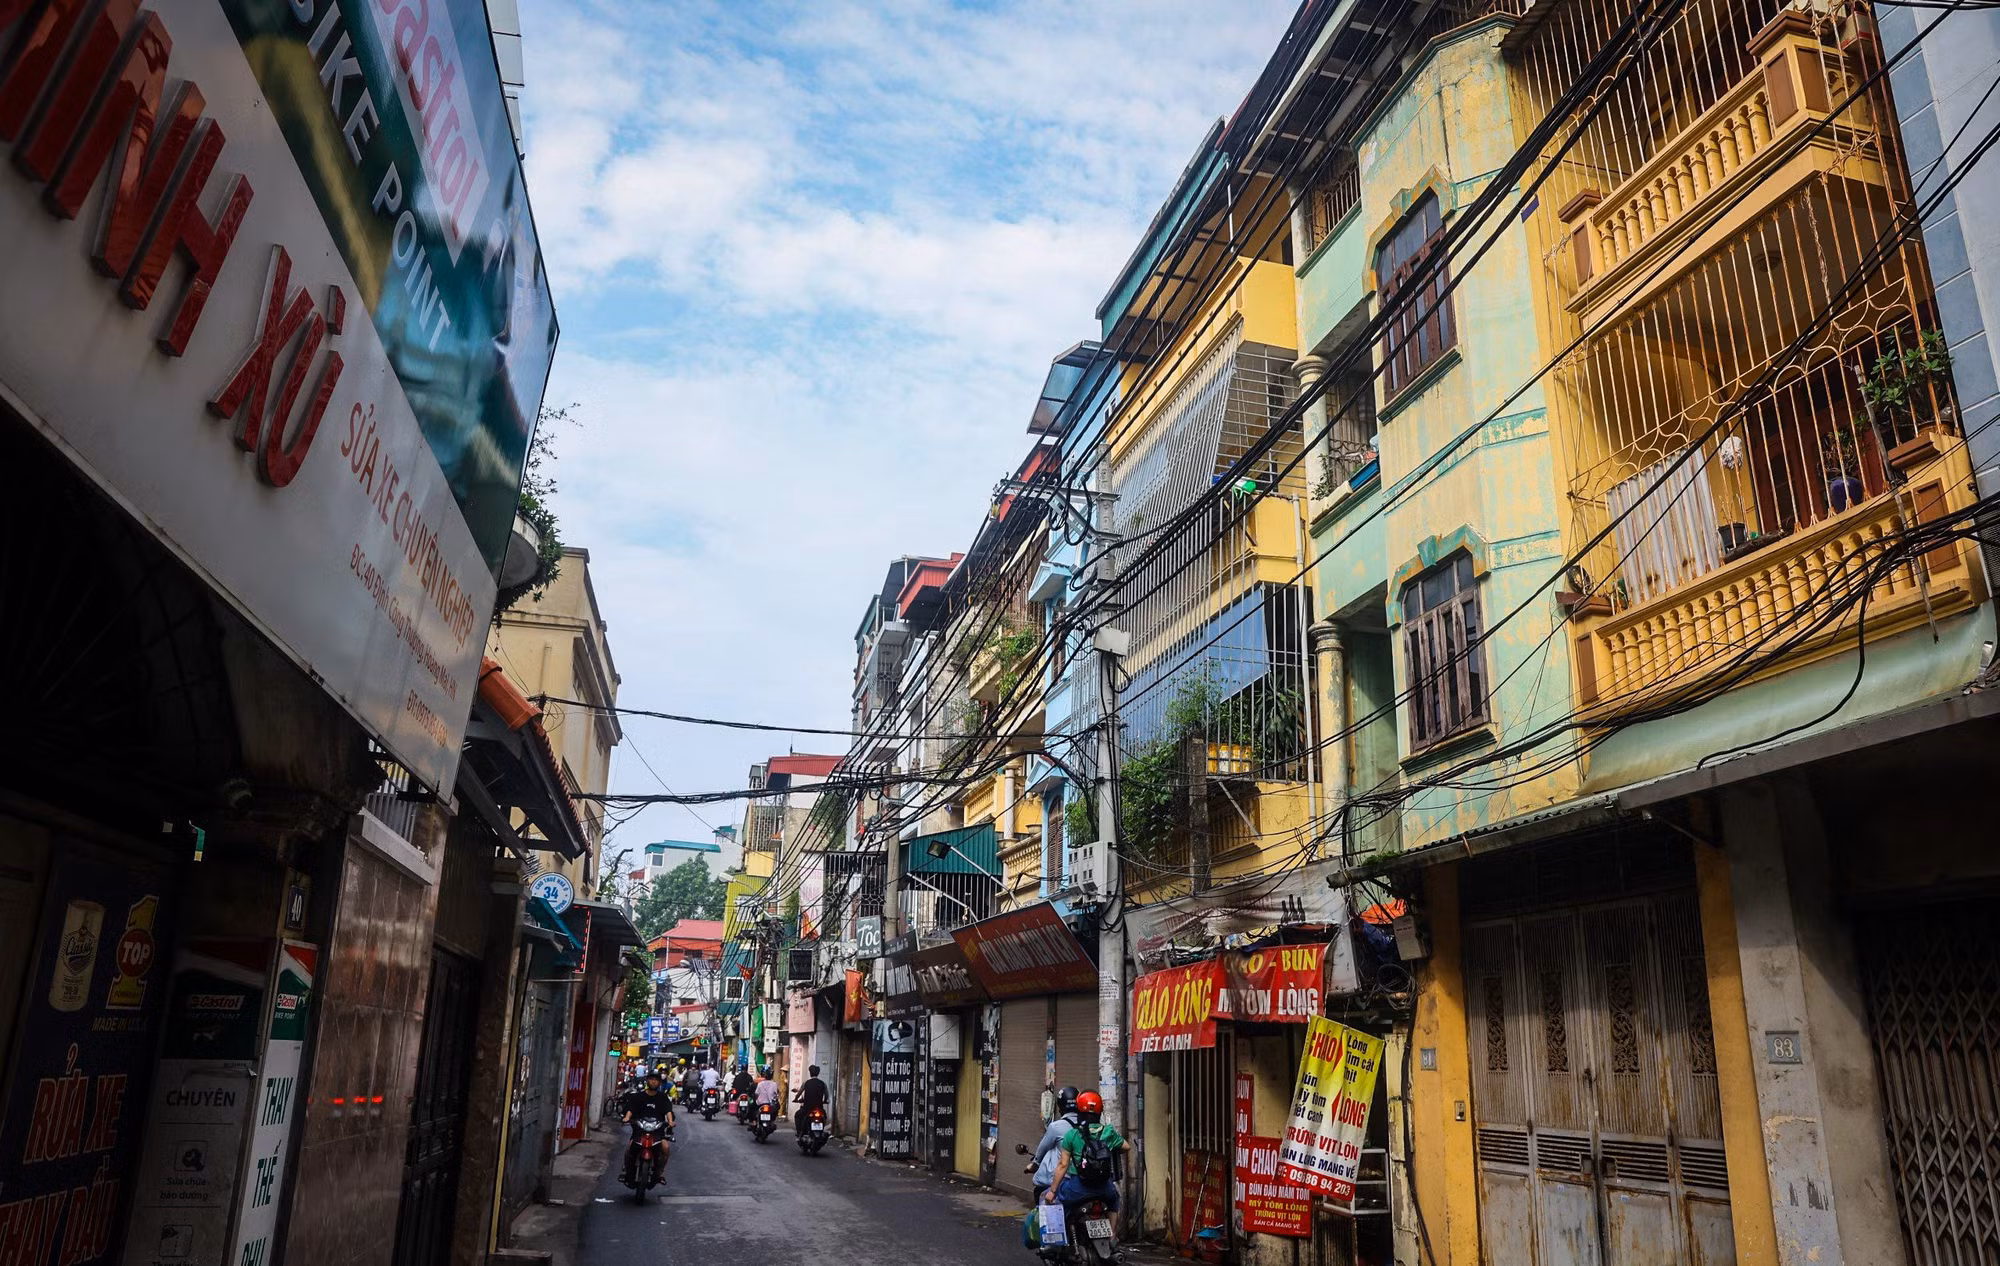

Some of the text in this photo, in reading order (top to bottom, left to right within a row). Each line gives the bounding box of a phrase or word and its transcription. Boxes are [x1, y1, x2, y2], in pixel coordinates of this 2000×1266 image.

[376, 0, 480, 240] astrol
[371, 160, 450, 352] POINT
[341, 402, 380, 496] SỬA
[373, 453, 400, 526] XE
[392, 490, 444, 600] CHUYÊN
[543, 886, 559, 899] 34
[291, 893, 302, 921] 40
[122, 941, 150, 966] TOP
[1281, 945, 1318, 972] BÚN
[200, 996, 241, 1008] Castrol
[1277, 981, 1319, 1016] LÒNG
[1141, 1031, 1160, 1053] TIẾT
[1162, 1033, 1193, 1051] CANH
[1347, 1035, 1368, 1055] Lòng
[1773, 1037, 1795, 1059] 83
[899, 1060, 911, 1076] TÓC
[1361, 1058, 1375, 1074] cật
[166, 1087, 236, 1107] CHUYÊN
[885, 1080, 900, 1094] NAM
[22, 1042, 128, 1165] RỬA XE
[261, 1077, 294, 1126] THAY
[1338, 1091, 1367, 1129] LÒNG
[1319, 1136, 1338, 1155] VỊT
[1337, 1141, 1359, 1161] LỘN
[252, 1139, 282, 1208] THẾ
[1318, 1159, 1344, 1176] MANG
[1248, 1180, 1263, 1196] BÚN
[1263, 1182, 1278, 1200] ĐẬU
[1320, 1178, 1334, 1191] 94
